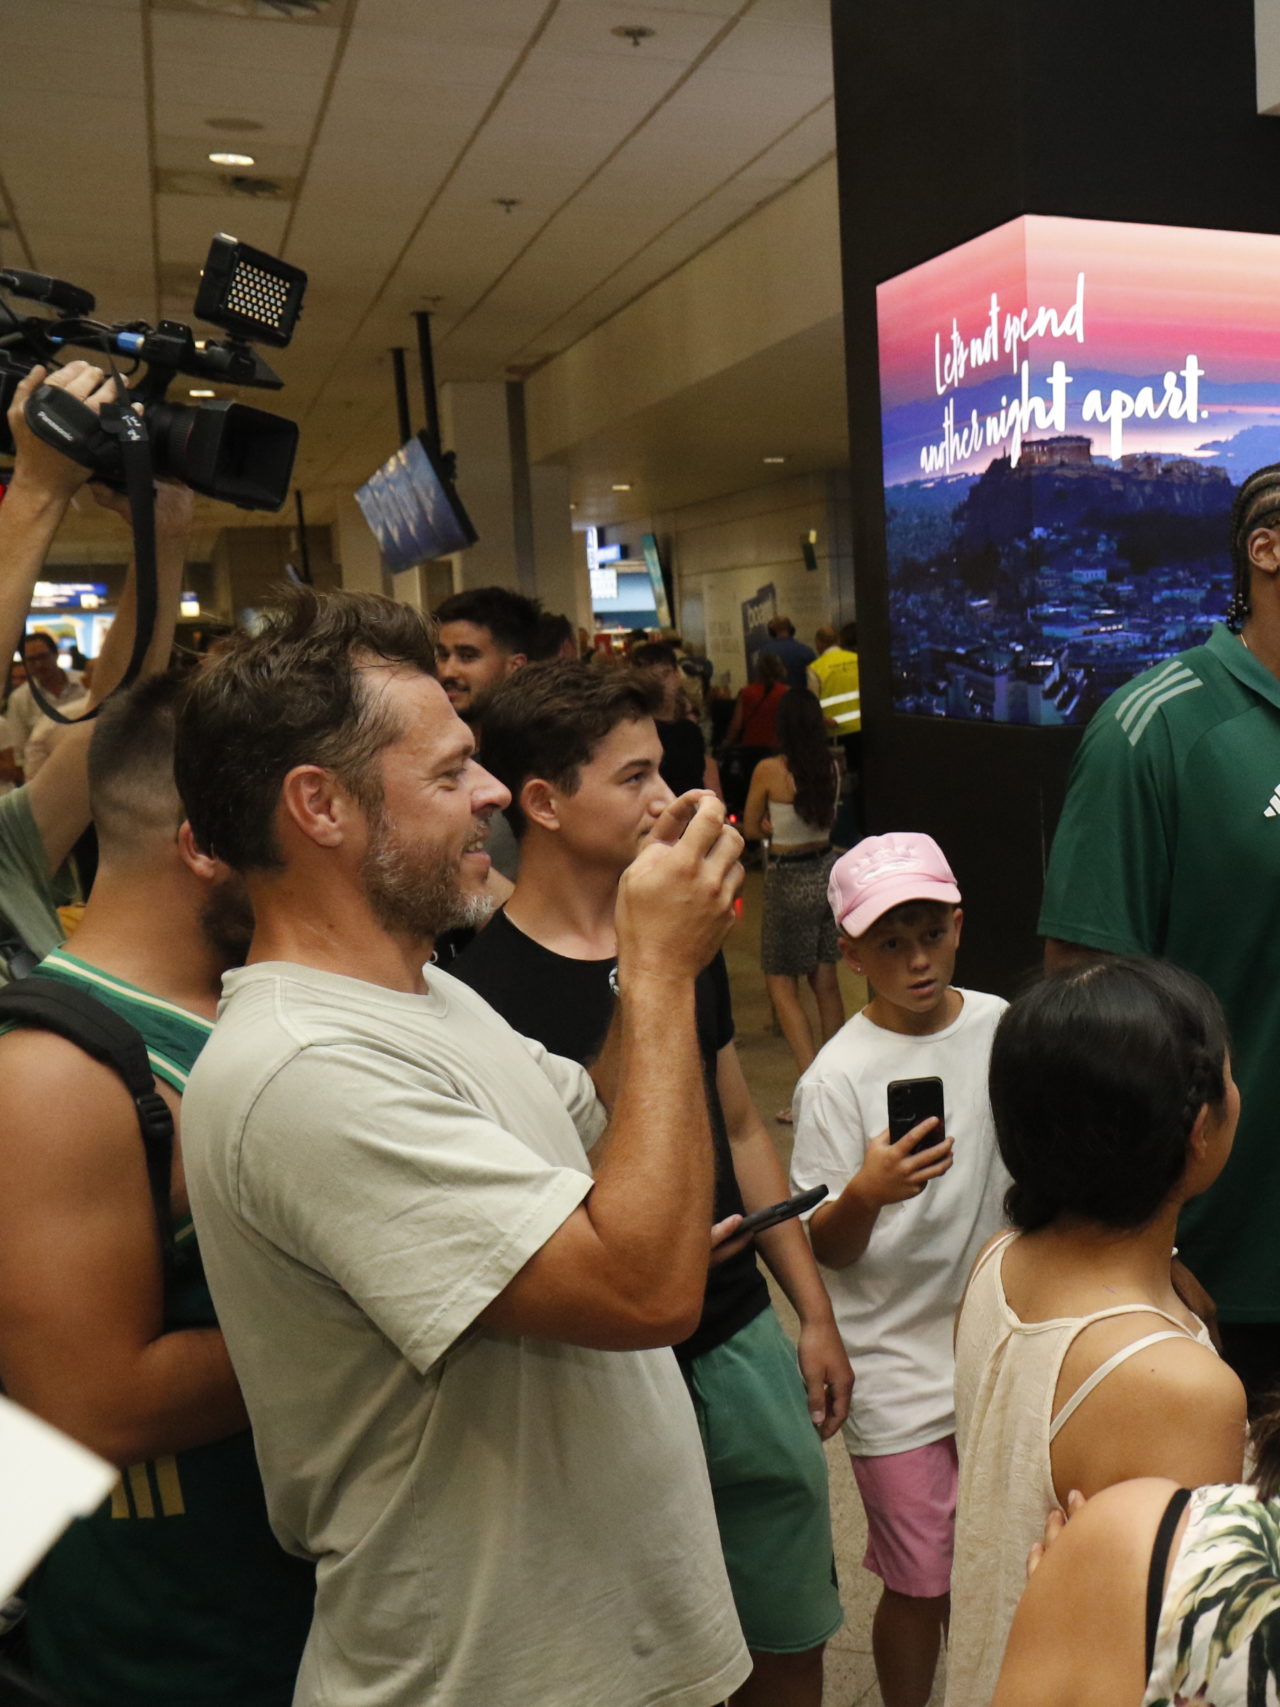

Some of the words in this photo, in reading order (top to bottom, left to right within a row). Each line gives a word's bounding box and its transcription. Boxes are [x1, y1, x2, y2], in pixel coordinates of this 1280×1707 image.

[970, 292, 1001, 368] not
[1003, 271, 1085, 375] spend
[920, 398, 983, 475] another
[986, 360, 1073, 469] night
[1082, 354, 1208, 461] apart.
